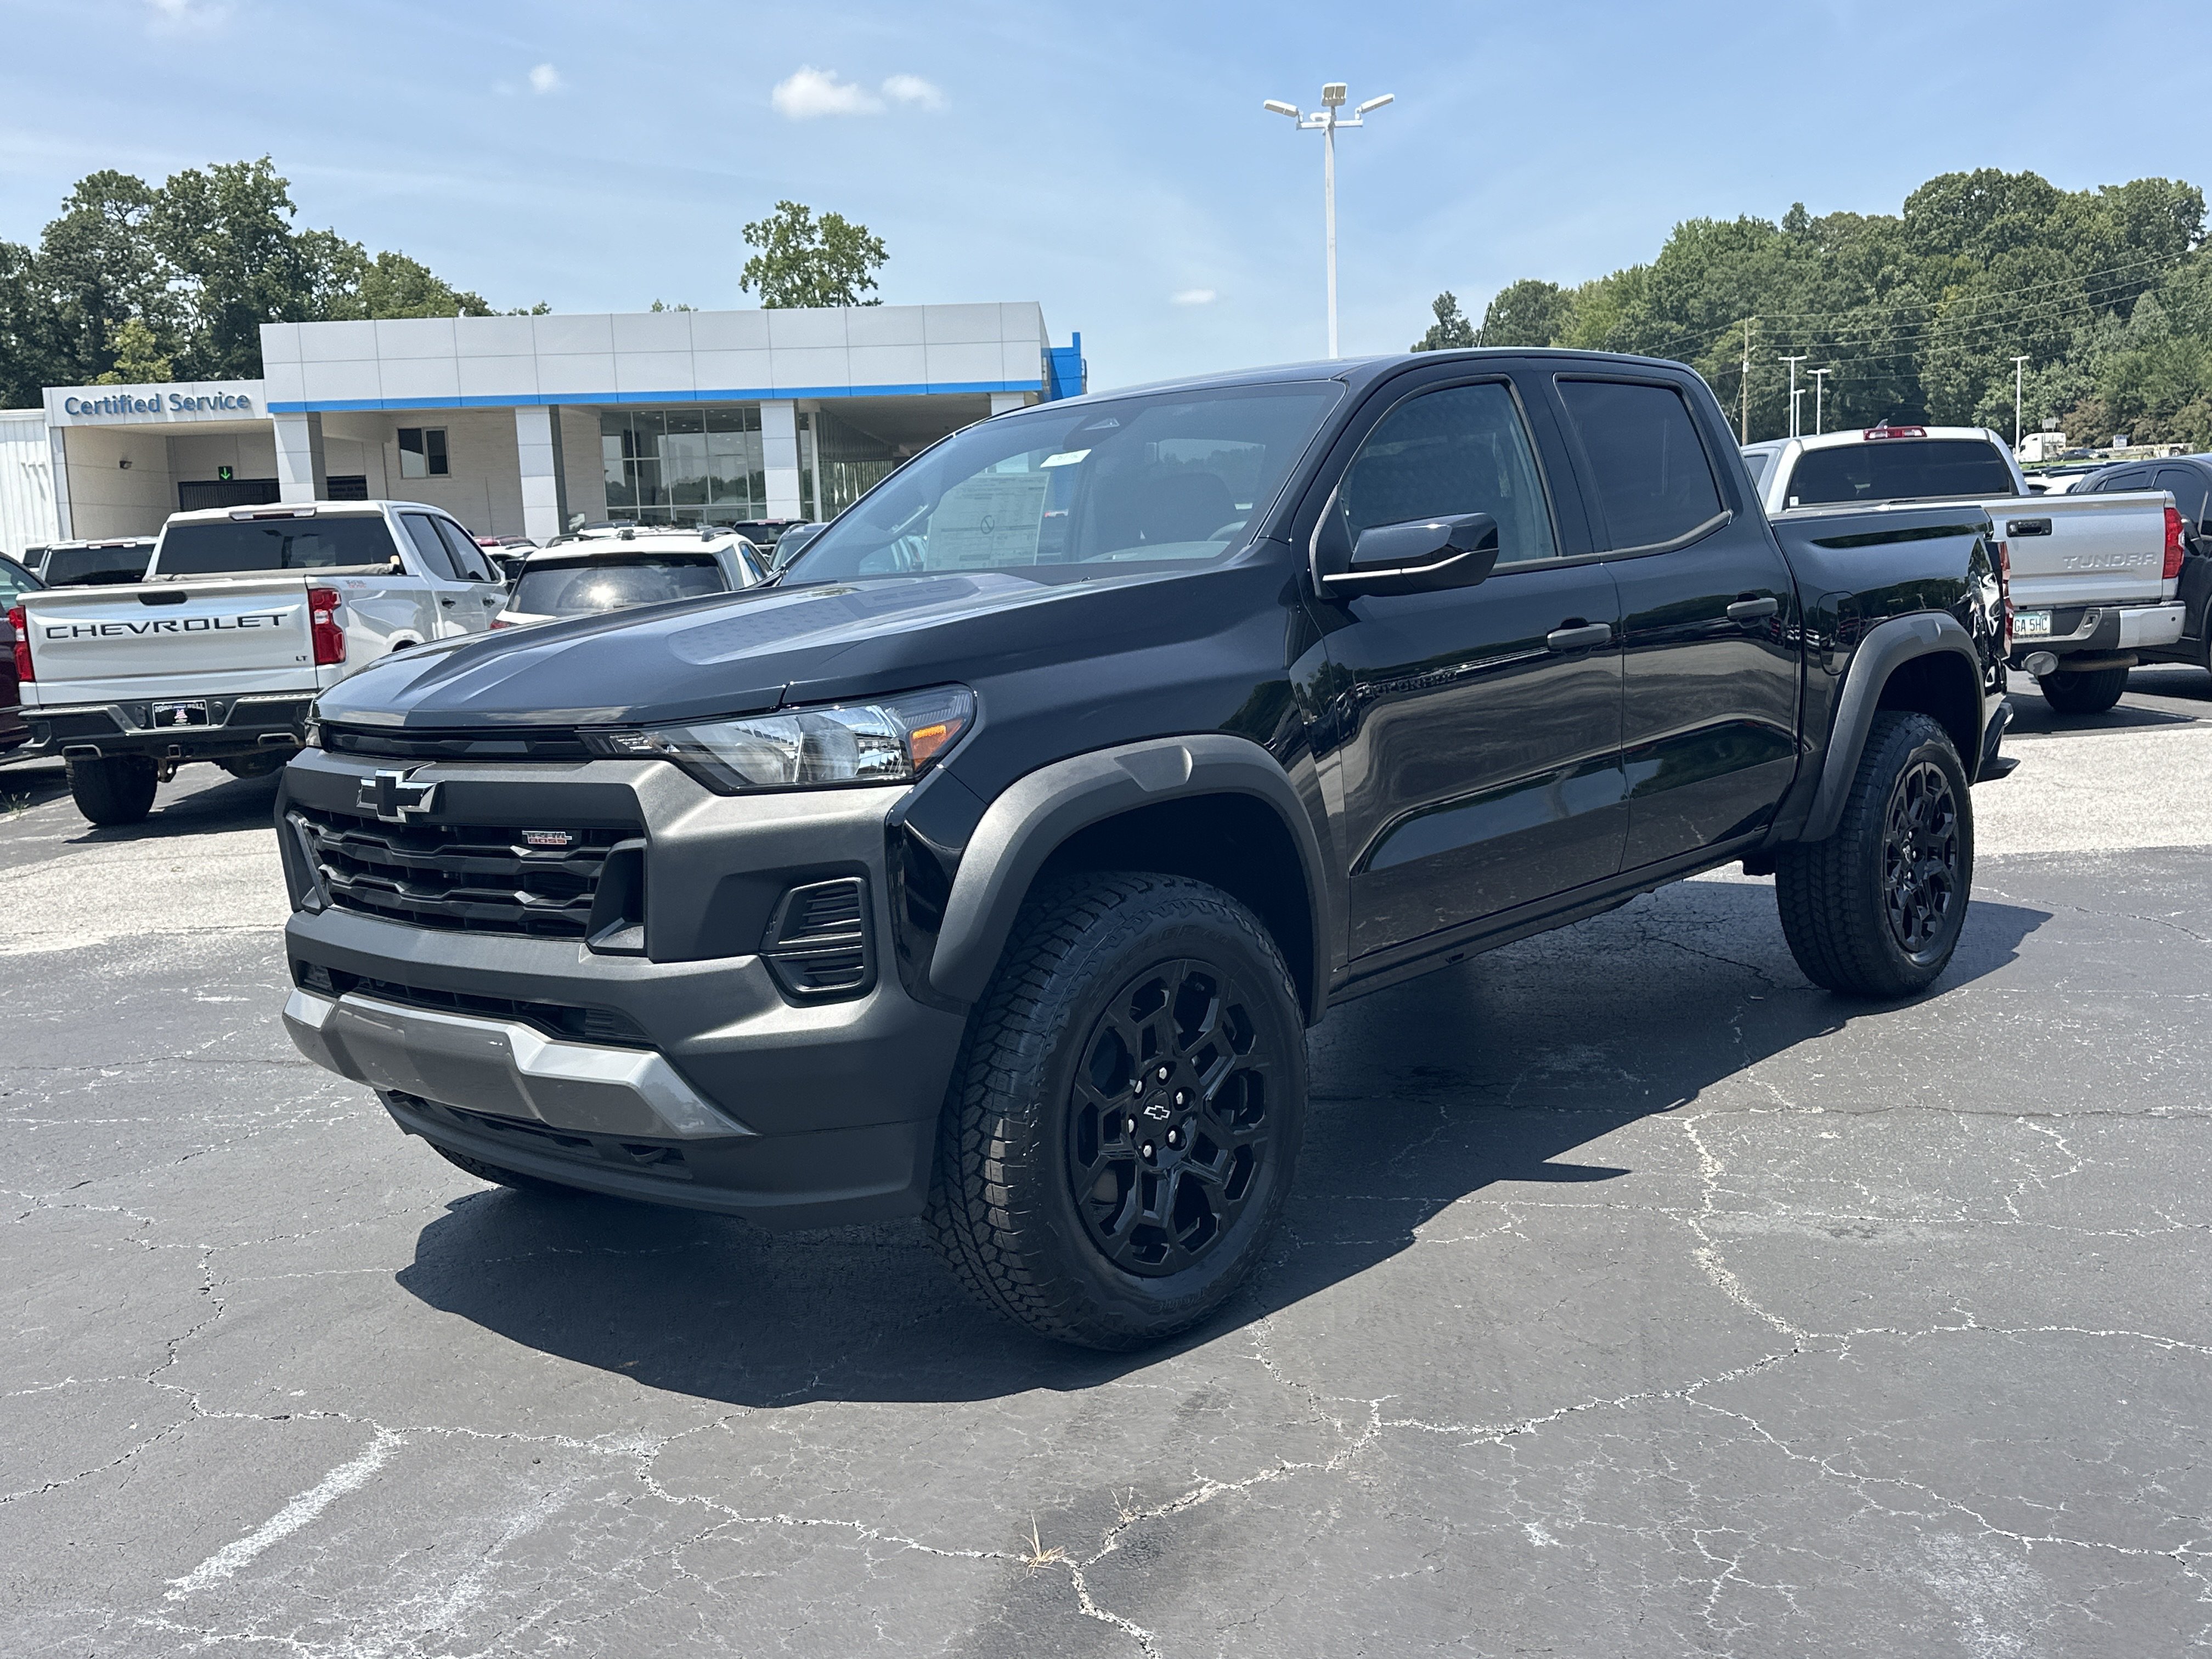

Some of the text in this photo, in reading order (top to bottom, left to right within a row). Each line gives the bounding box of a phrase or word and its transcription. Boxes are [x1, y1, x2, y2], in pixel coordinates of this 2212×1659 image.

[65, 391, 250, 415] Certified Service
[2063, 552, 2157, 569] TUNDRA
[46, 614, 287, 639] CHEVROLET
[2029, 617, 2047, 631] 5HC
